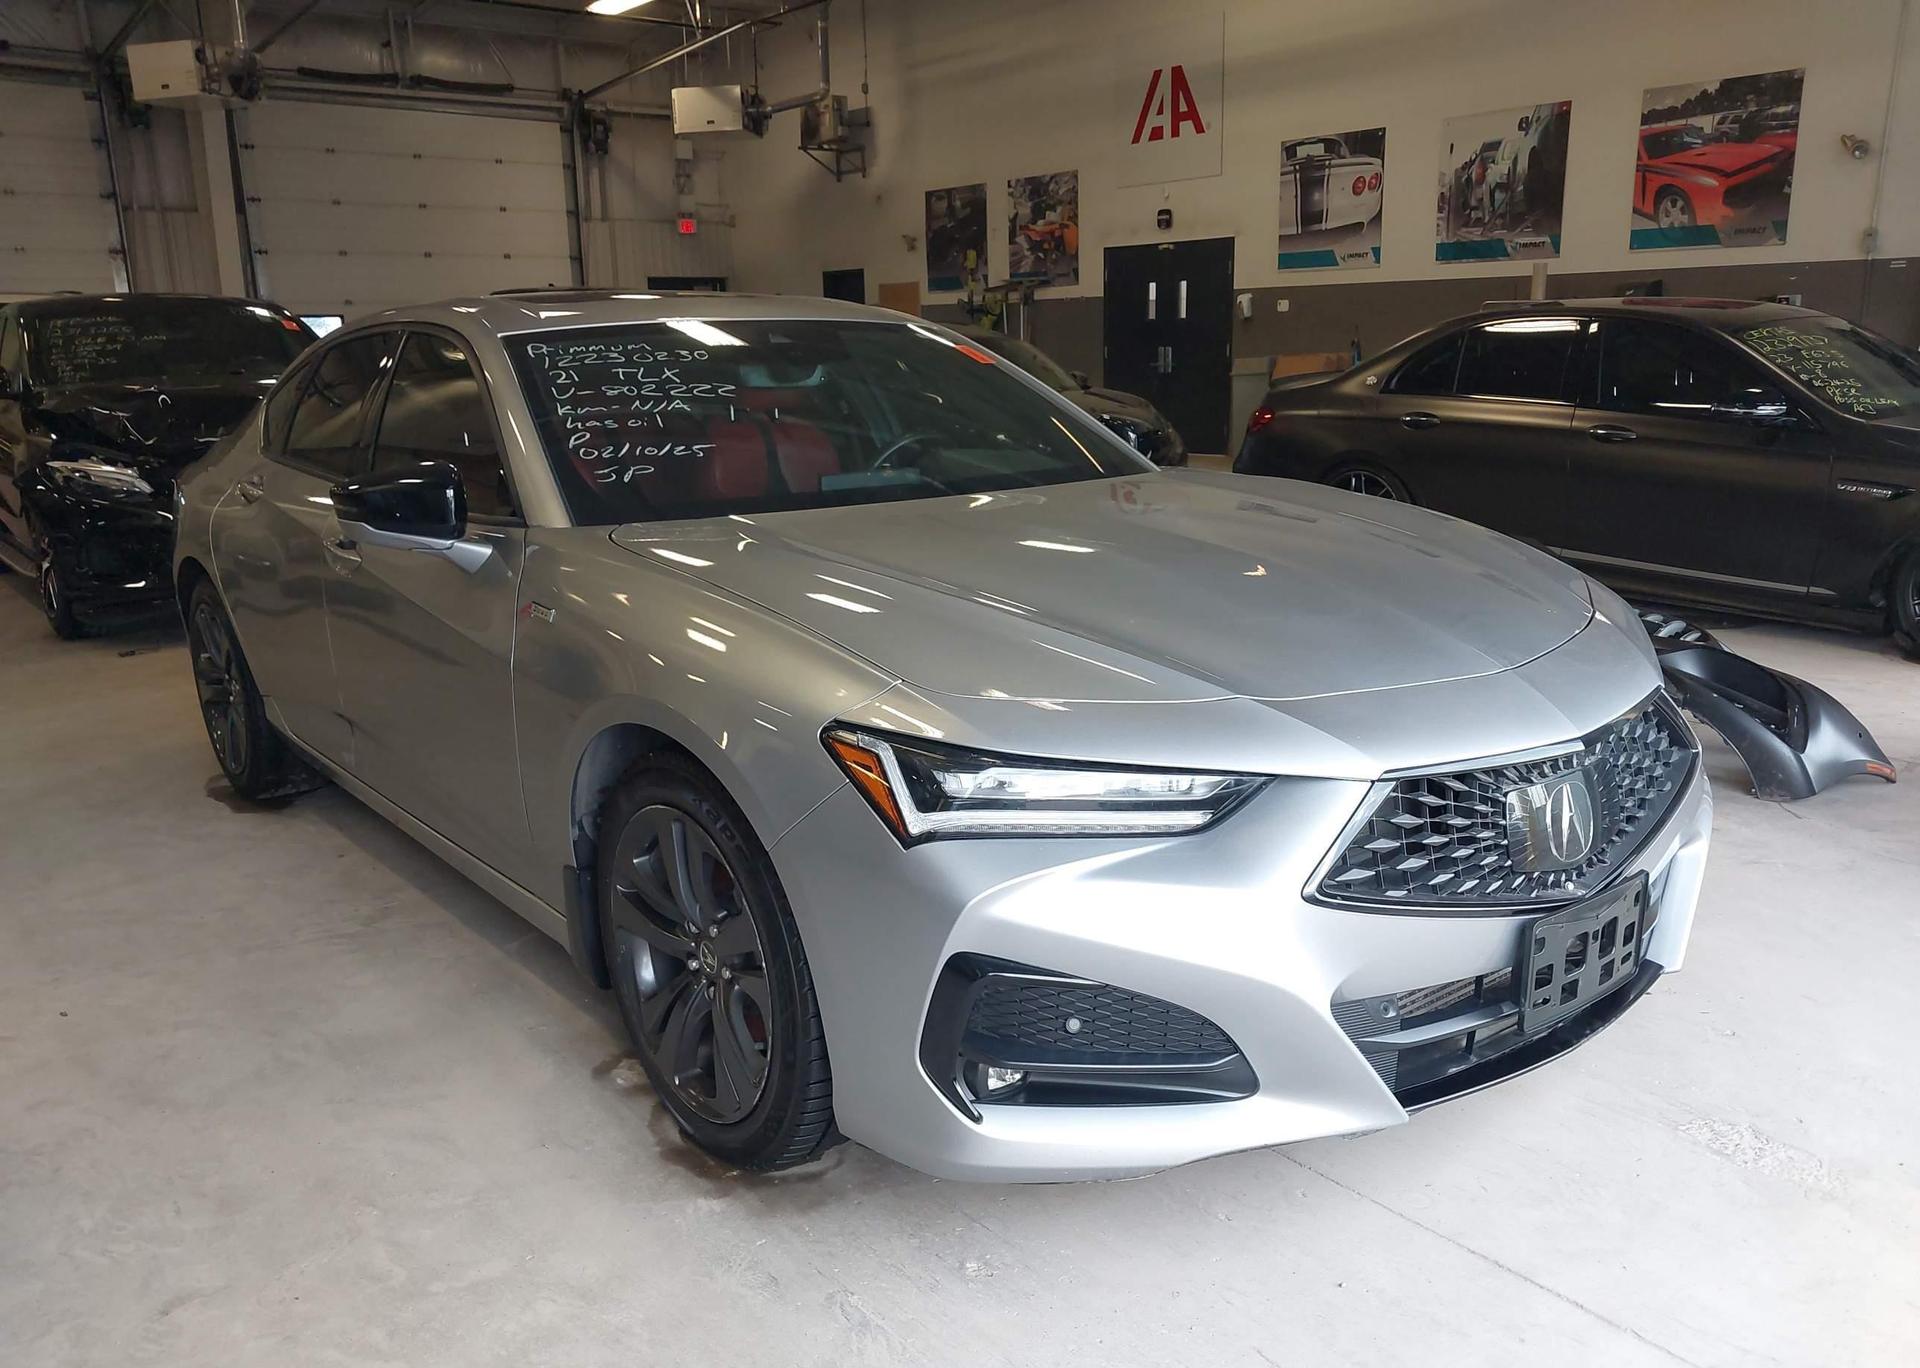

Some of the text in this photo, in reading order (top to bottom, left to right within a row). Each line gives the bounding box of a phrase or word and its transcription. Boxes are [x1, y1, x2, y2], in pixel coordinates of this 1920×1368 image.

[1346, 252, 1369, 260] IMPACT
[550, 367, 681, 383] 21 TLX
[631, 400, 692, 413] N/A
[567, 413, 664, 429] has oil
[579, 442, 717, 458] 02/10/25
